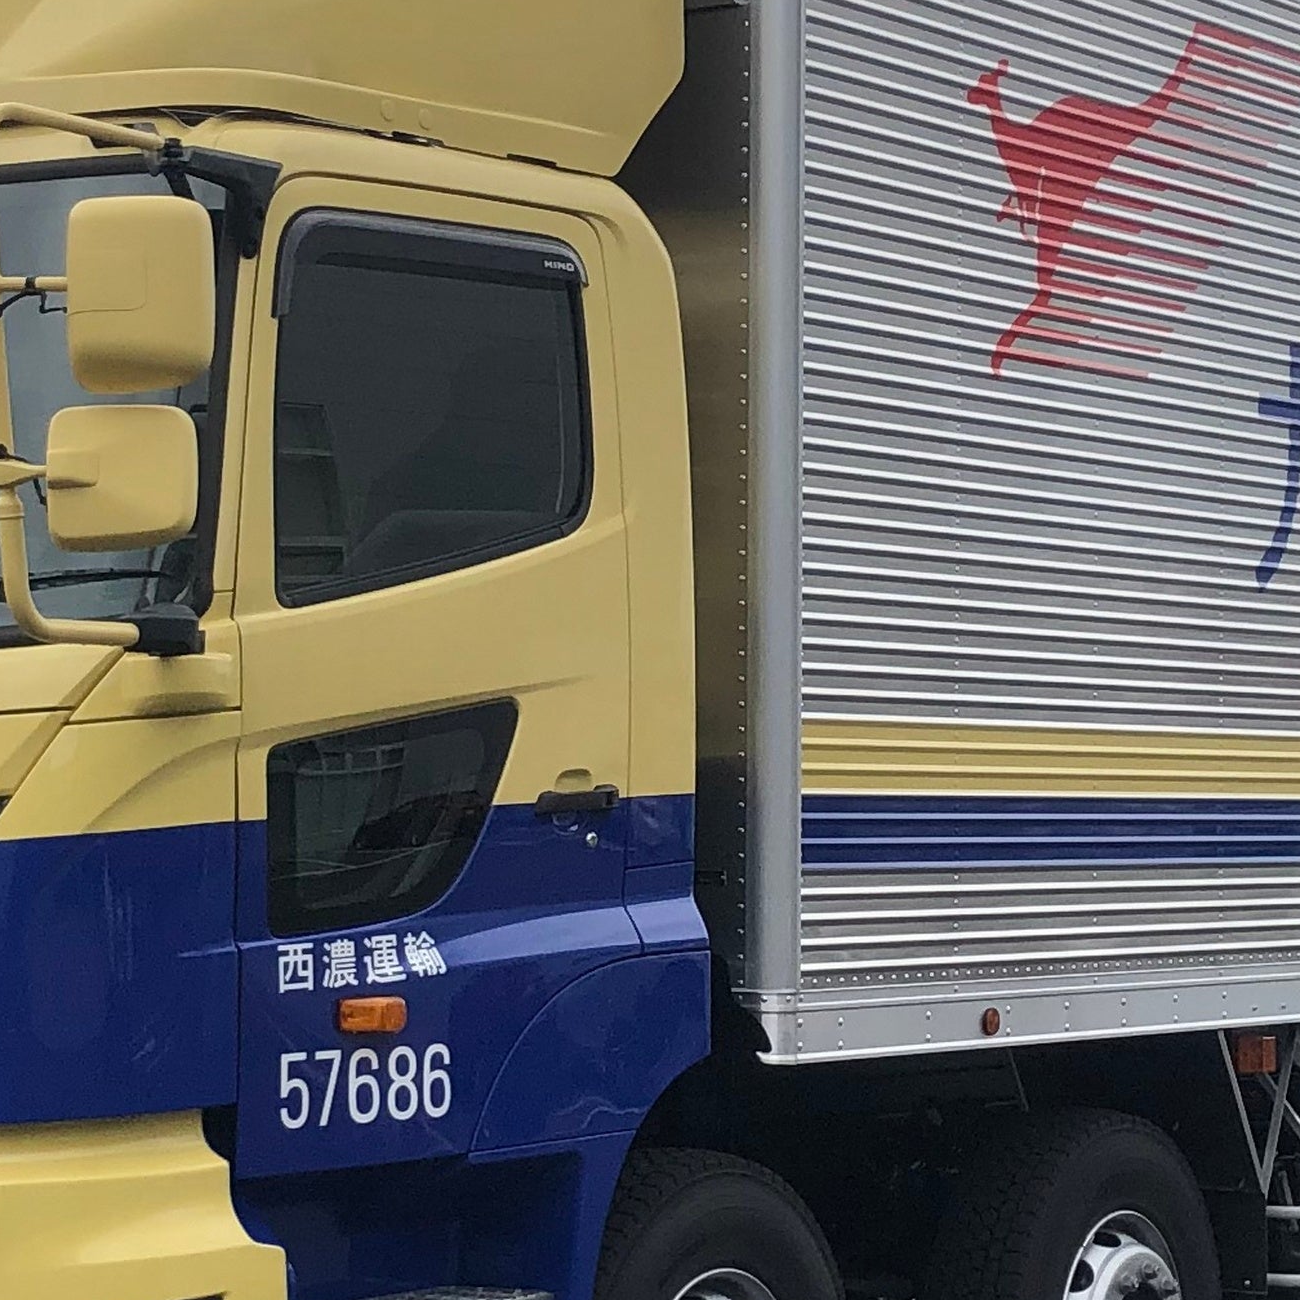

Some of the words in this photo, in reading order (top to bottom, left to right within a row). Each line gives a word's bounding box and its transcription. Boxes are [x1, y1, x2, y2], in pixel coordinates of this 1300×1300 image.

[544, 260, 575, 271] HINO
[277, 931, 447, 993] 西濃運輸
[279, 1043, 451, 1129] 57686
